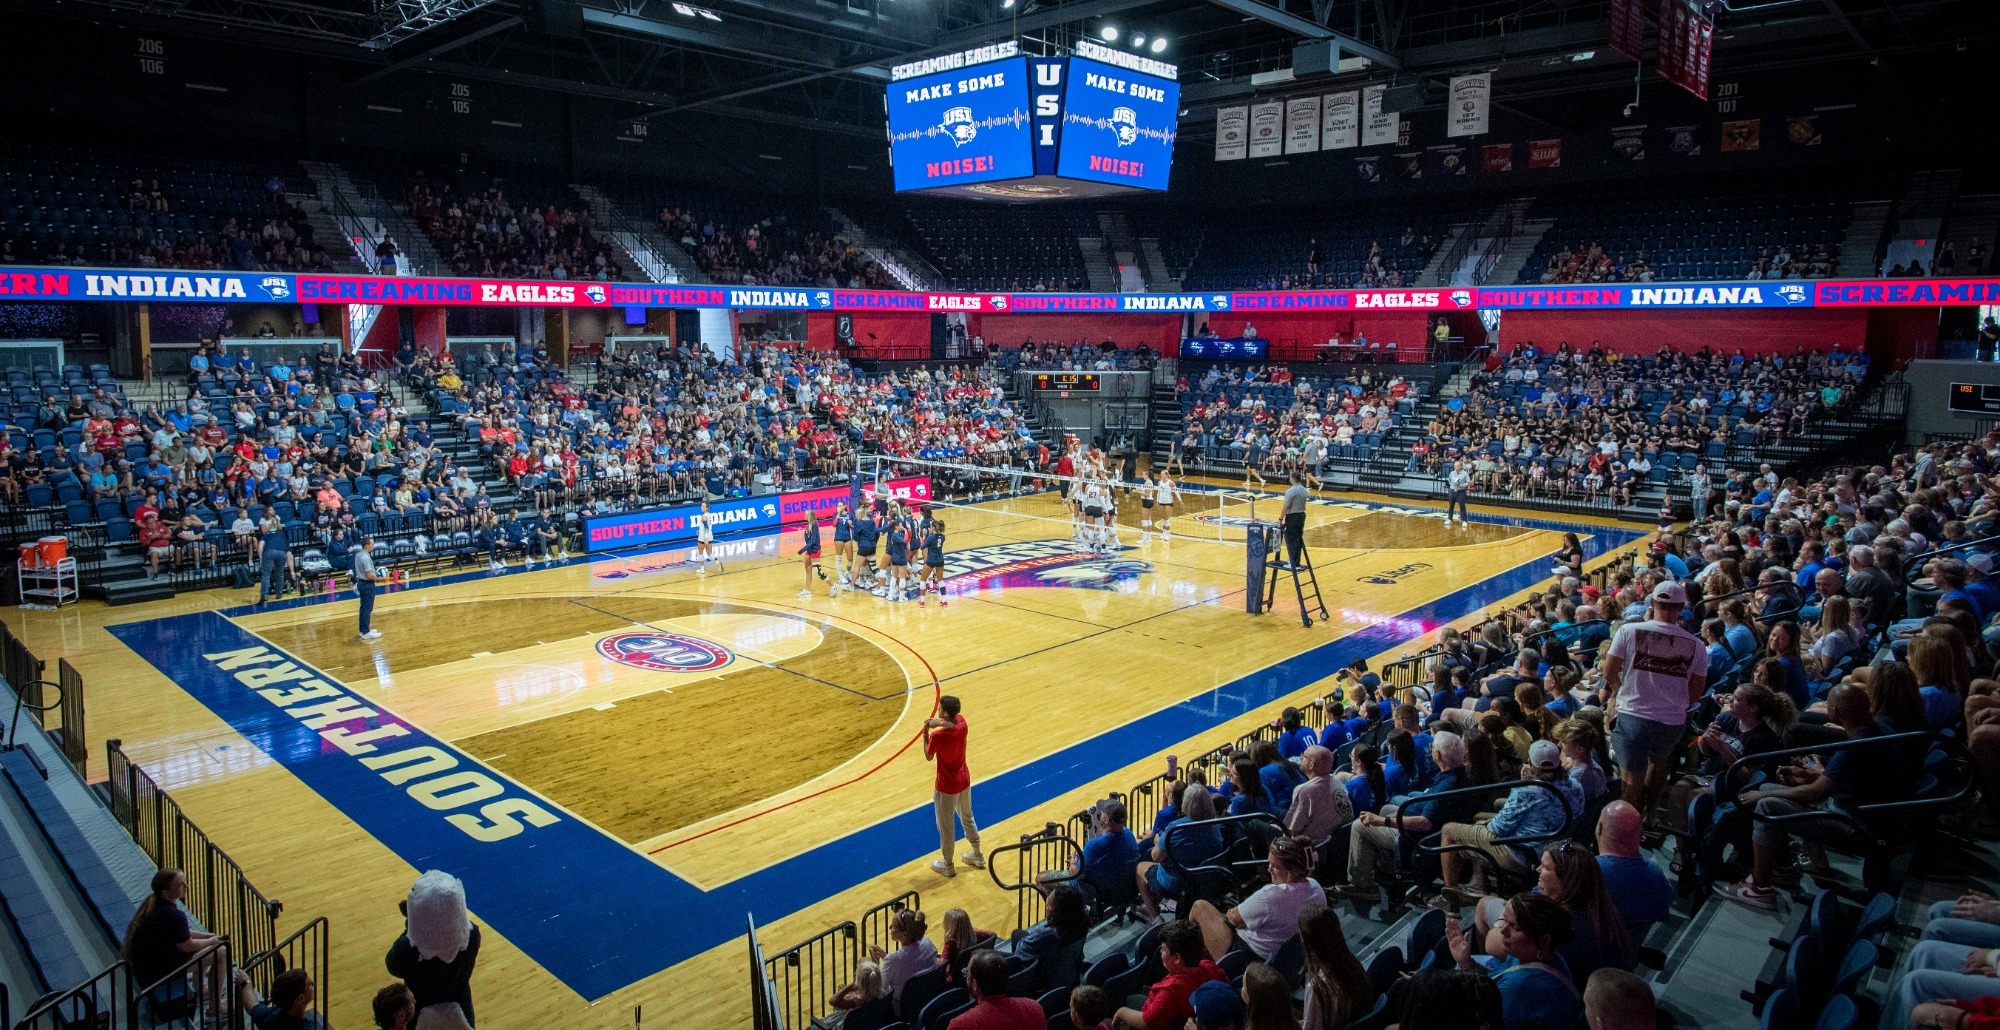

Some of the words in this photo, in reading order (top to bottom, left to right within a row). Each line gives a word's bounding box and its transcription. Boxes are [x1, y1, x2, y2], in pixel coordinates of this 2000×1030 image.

[137, 38, 164, 55] 206
[139, 58, 165, 75] 106
[892, 52, 964, 81] SCREAMING
[965, 40, 1018, 66] EAGLES
[1076, 41, 1140, 70] SCREAMING
[1140, 58, 1178, 80] EAGLES
[450, 83, 470, 97] 205
[906, 83, 952, 103] MAKE
[958, 73, 1005, 94] SOME
[1085, 72, 1126, 94] MAKE
[1130, 83, 1165, 102] SOME
[1717, 83, 1739, 96] 201
[451, 100, 471, 114] 105
[1717, 100, 1737, 113] 101
[944, 107, 973, 126] USI
[1113, 109, 1137, 126] USI
[632, 124, 648, 137] 104
[926, 155, 994, 178] NOISE!
[1089, 155, 1144, 177] NOISE!
[85, 275, 246, 298] INDIANA
[302, 280, 472, 301] SCREAMING
[481, 284, 575, 303] EAGLES
[613, 287, 724, 305] SOUTHERN
[731, 290, 809, 306] INDIANA
[836, 293, 924, 309] SCREAMING
[929, 296, 981, 309] EAGLES
[1013, 297, 1117, 309] SOUTHERN
[1124, 296, 1205, 310] INDIANA
[1235, 293, 1349, 309] SCREAMING
[1355, 292, 1439, 308] EAGLES
[1479, 289, 1621, 306] SOUTHERN
[1630, 287, 1763, 305] INDIANA
[1041, 381, 1047, 389] 0
[1092, 381, 1098, 389] 0
[1960, 385, 1973, 393] USI
[1088, 491, 1097, 499] 27
[590, 517, 685, 543] SOUTHERN
[937, 539, 942, 548] 2
[622, 638, 708, 664] OVC
[202, 645, 562, 842] SOUTHERN
